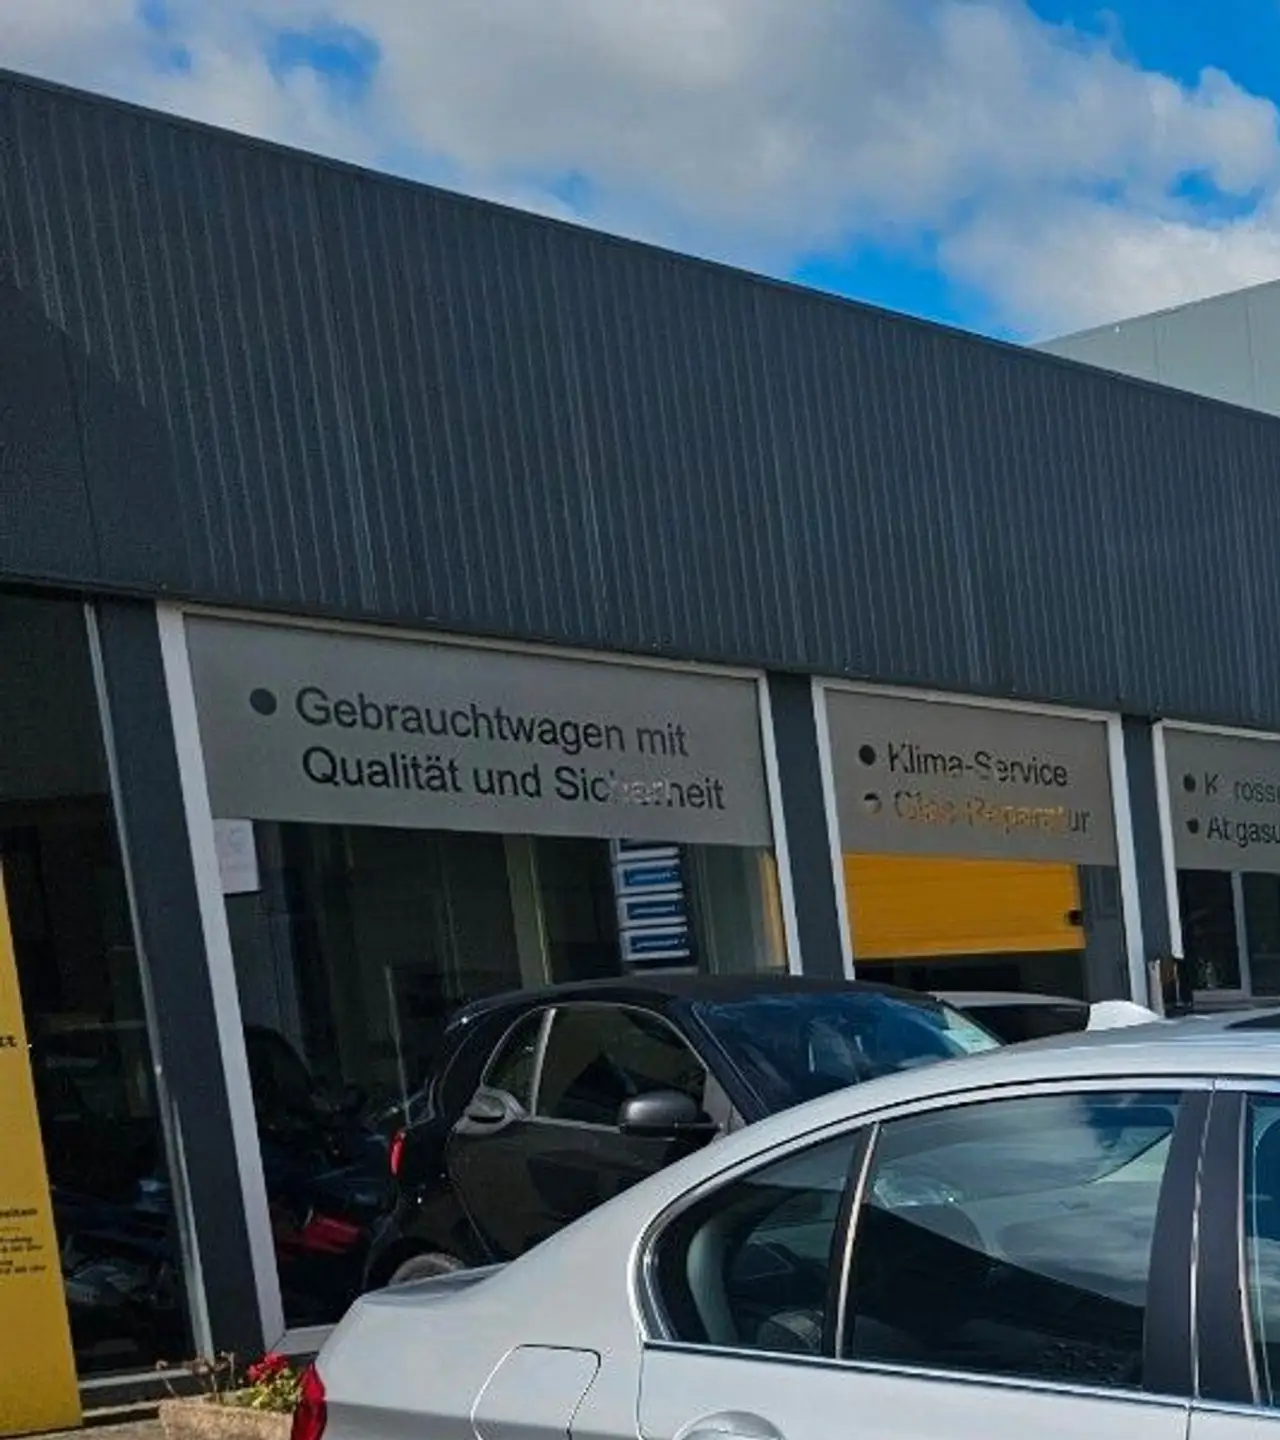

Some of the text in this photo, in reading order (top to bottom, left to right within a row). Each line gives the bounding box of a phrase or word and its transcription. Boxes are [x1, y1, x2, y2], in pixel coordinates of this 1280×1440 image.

[295, 685, 690, 758] Gebrauchtwagen mit
[302, 745, 463, 793] Qualität
[472, 762, 542, 799] und
[888, 740, 1069, 788] Klima-Service
